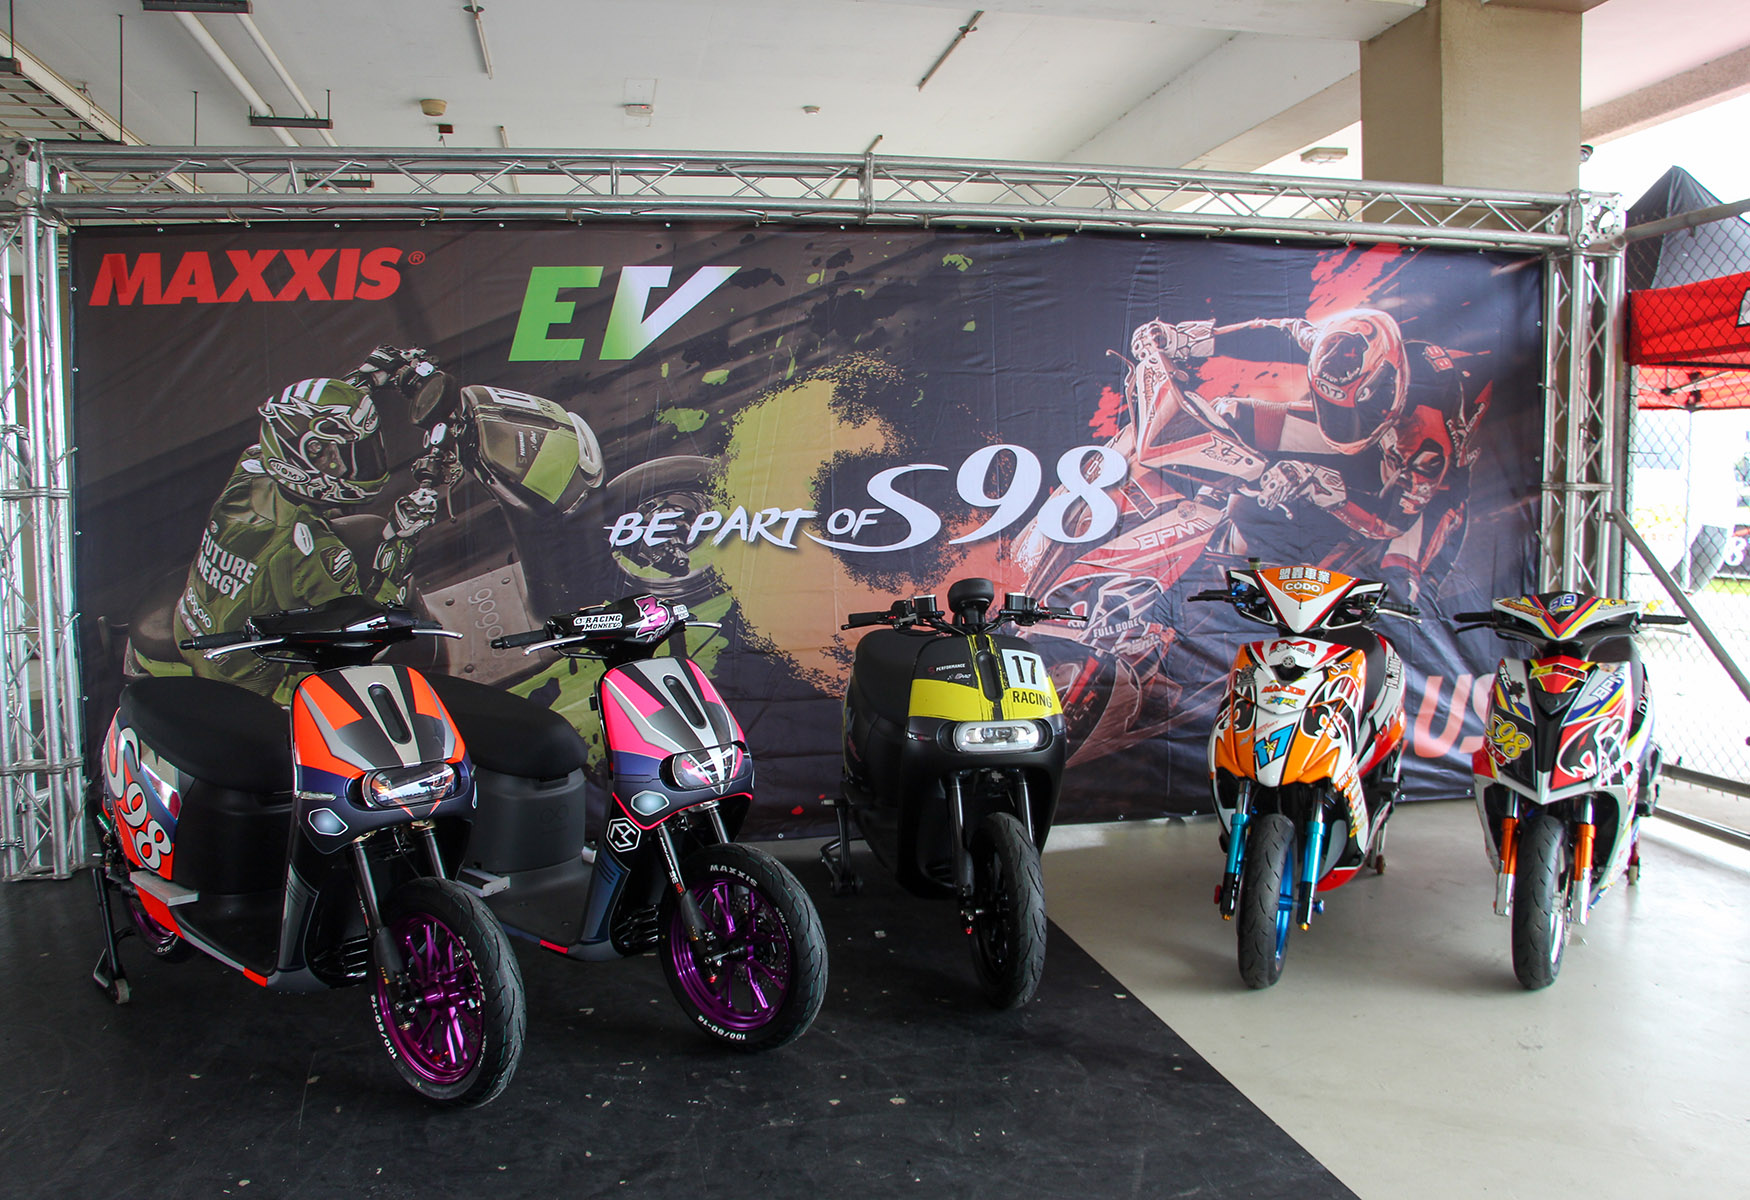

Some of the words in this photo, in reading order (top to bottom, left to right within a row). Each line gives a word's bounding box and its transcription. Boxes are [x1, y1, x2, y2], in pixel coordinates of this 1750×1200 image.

[88, 247, 402, 306] MAXXIS
[508, 266, 742, 361] EV
[802, 444, 1128, 553] S98
[604, 511, 685, 548] BE
[686, 505, 818, 549] PART
[827, 508, 886, 539] OF
[1140, 521, 1203, 550] BPM
[197, 551, 245, 600] NERGY
[201, 528, 258, 584] FUTURE
[1285, 582, 1321, 592] CODO
[187, 587, 212, 629] gogoro
[468, 588, 508, 658] gogo
[1093, 626, 1115, 638] FULL
[1115, 618, 1139, 633] BORE
[1011, 655, 1037, 685] 17
[1012, 690, 1053, 709] RACING
[1253, 722, 1296, 770] 17
[709, 864, 758, 887] MAXXIS
[697, 1015, 746, 1040] 100/80-14
